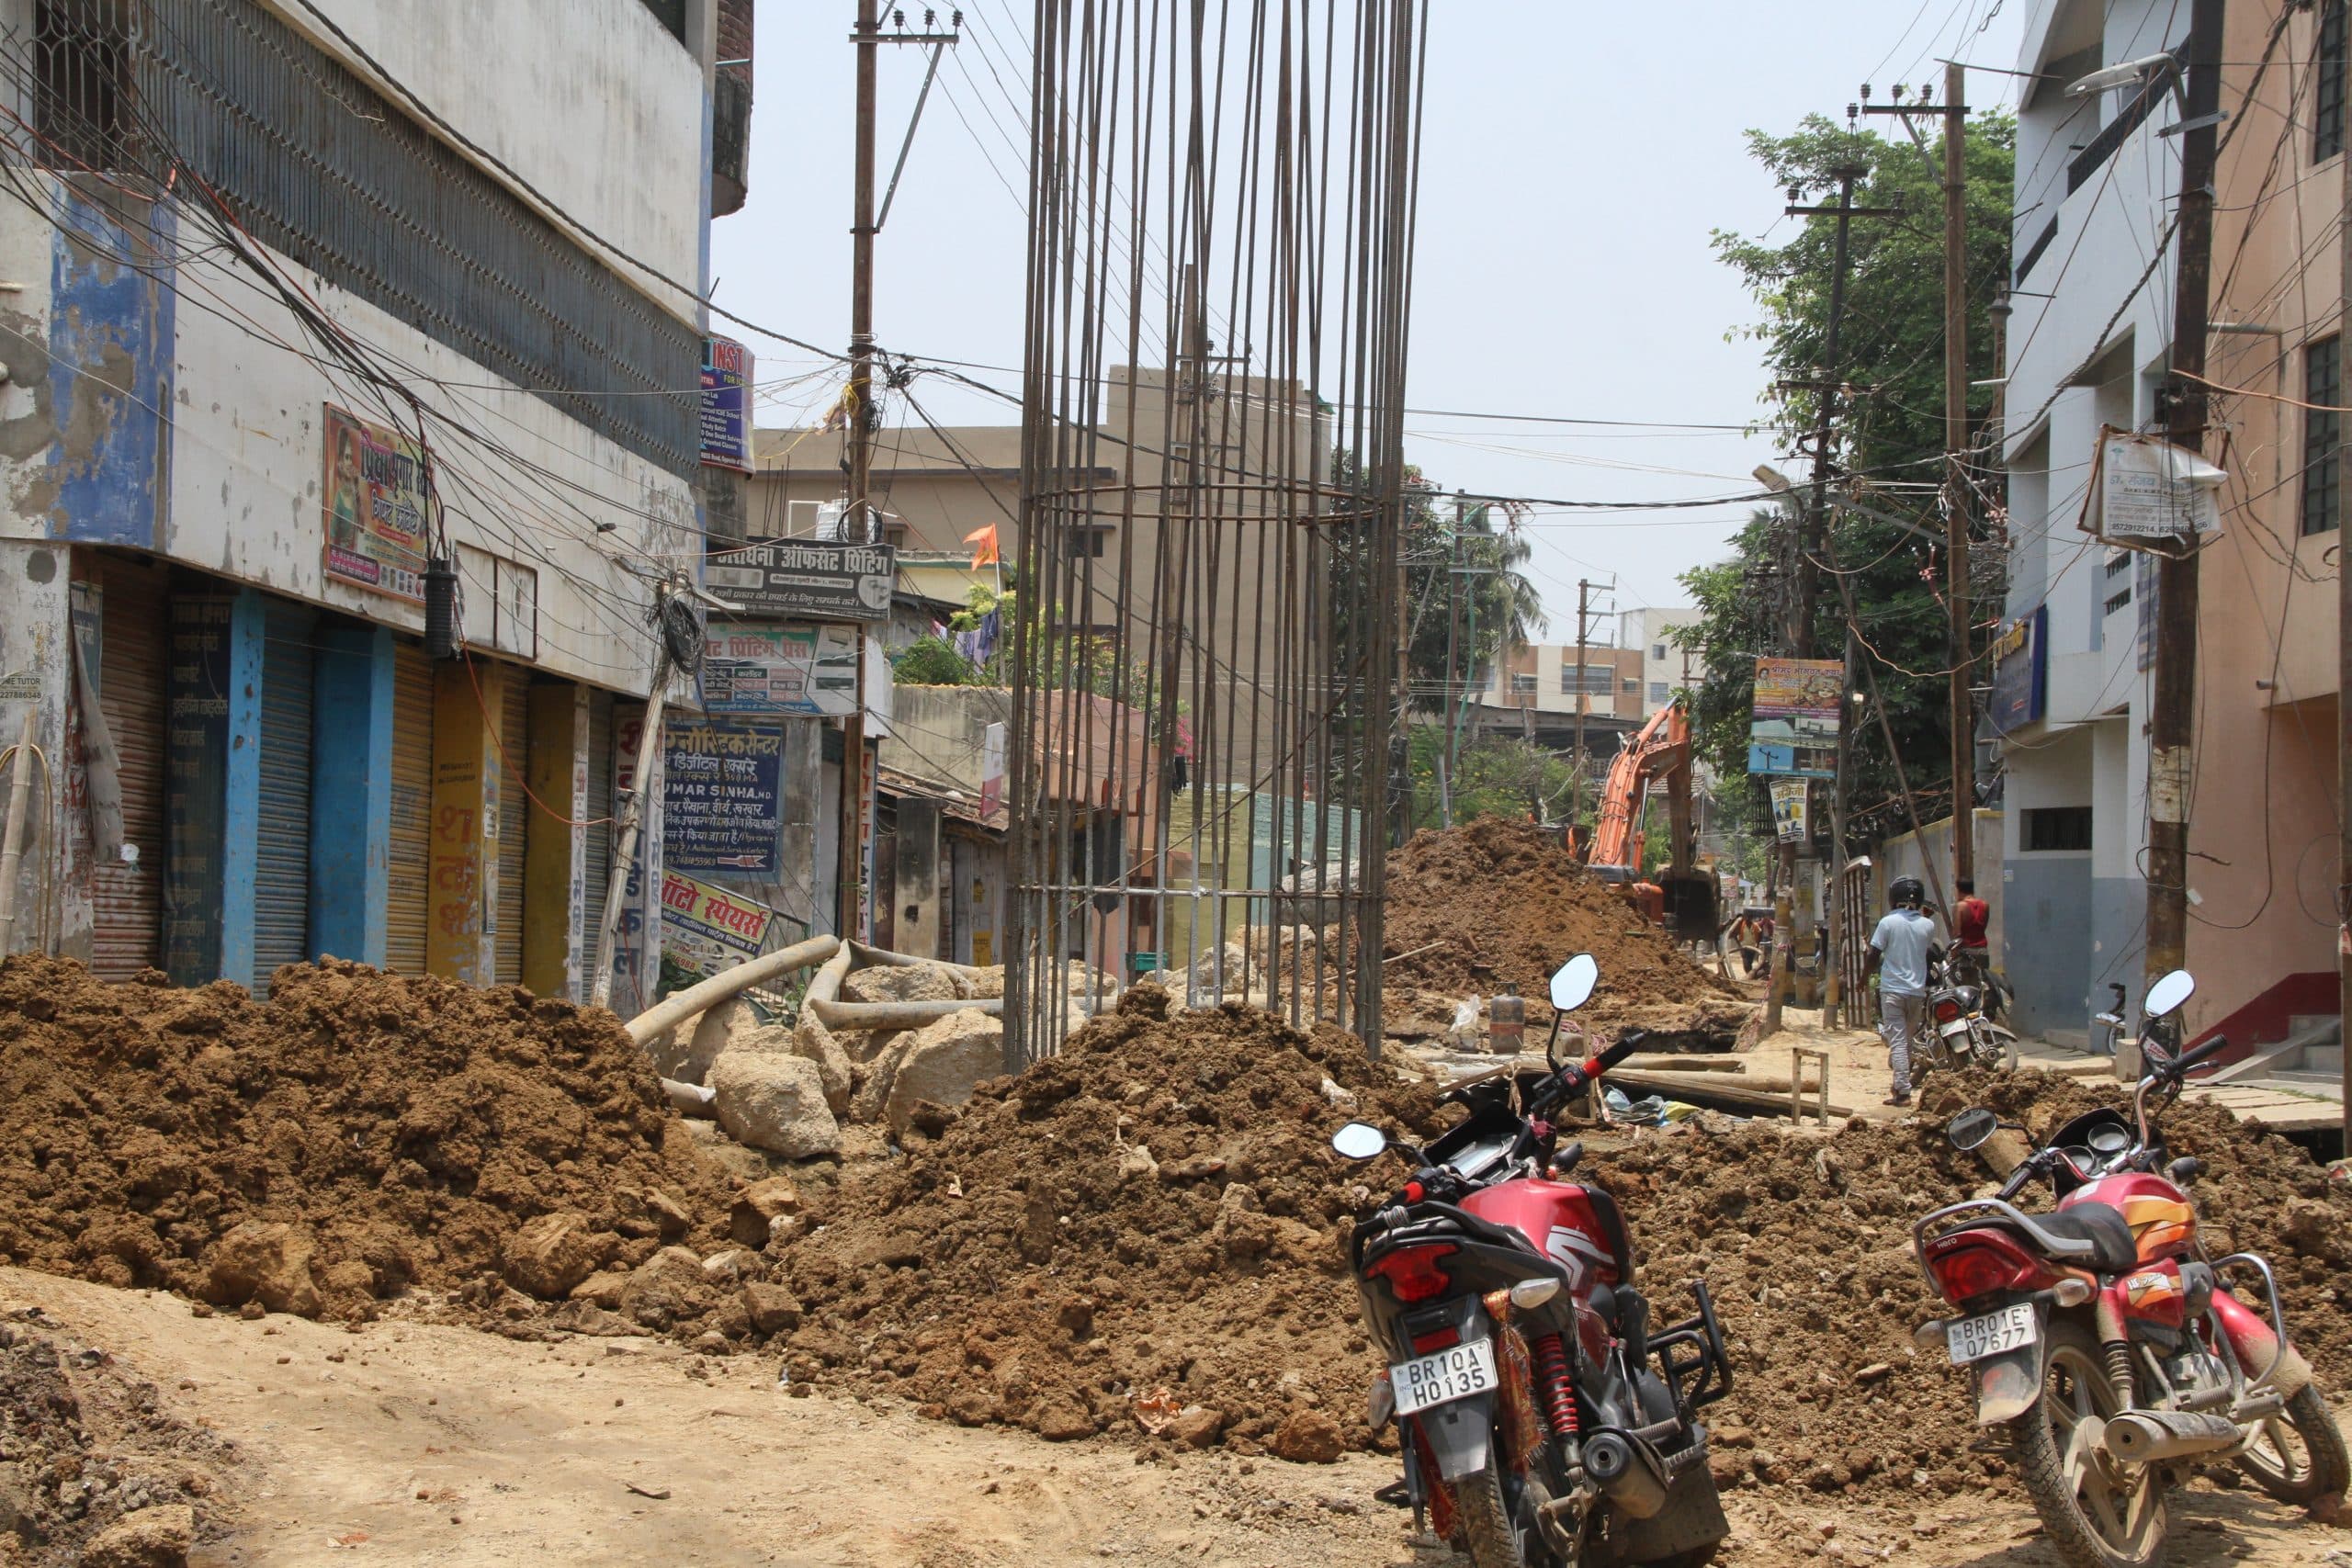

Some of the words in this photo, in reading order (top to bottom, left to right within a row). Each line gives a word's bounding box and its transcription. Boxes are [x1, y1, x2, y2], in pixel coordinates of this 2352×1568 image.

[781, 544, 840, 571] ऑफसेट
[663, 783, 706, 796] UMAR
[1937, 1236, 1958, 1250] Hero
[1962, 1308, 2023, 1338] BR01E
[1408, 1348, 1480, 1385] BR10A
